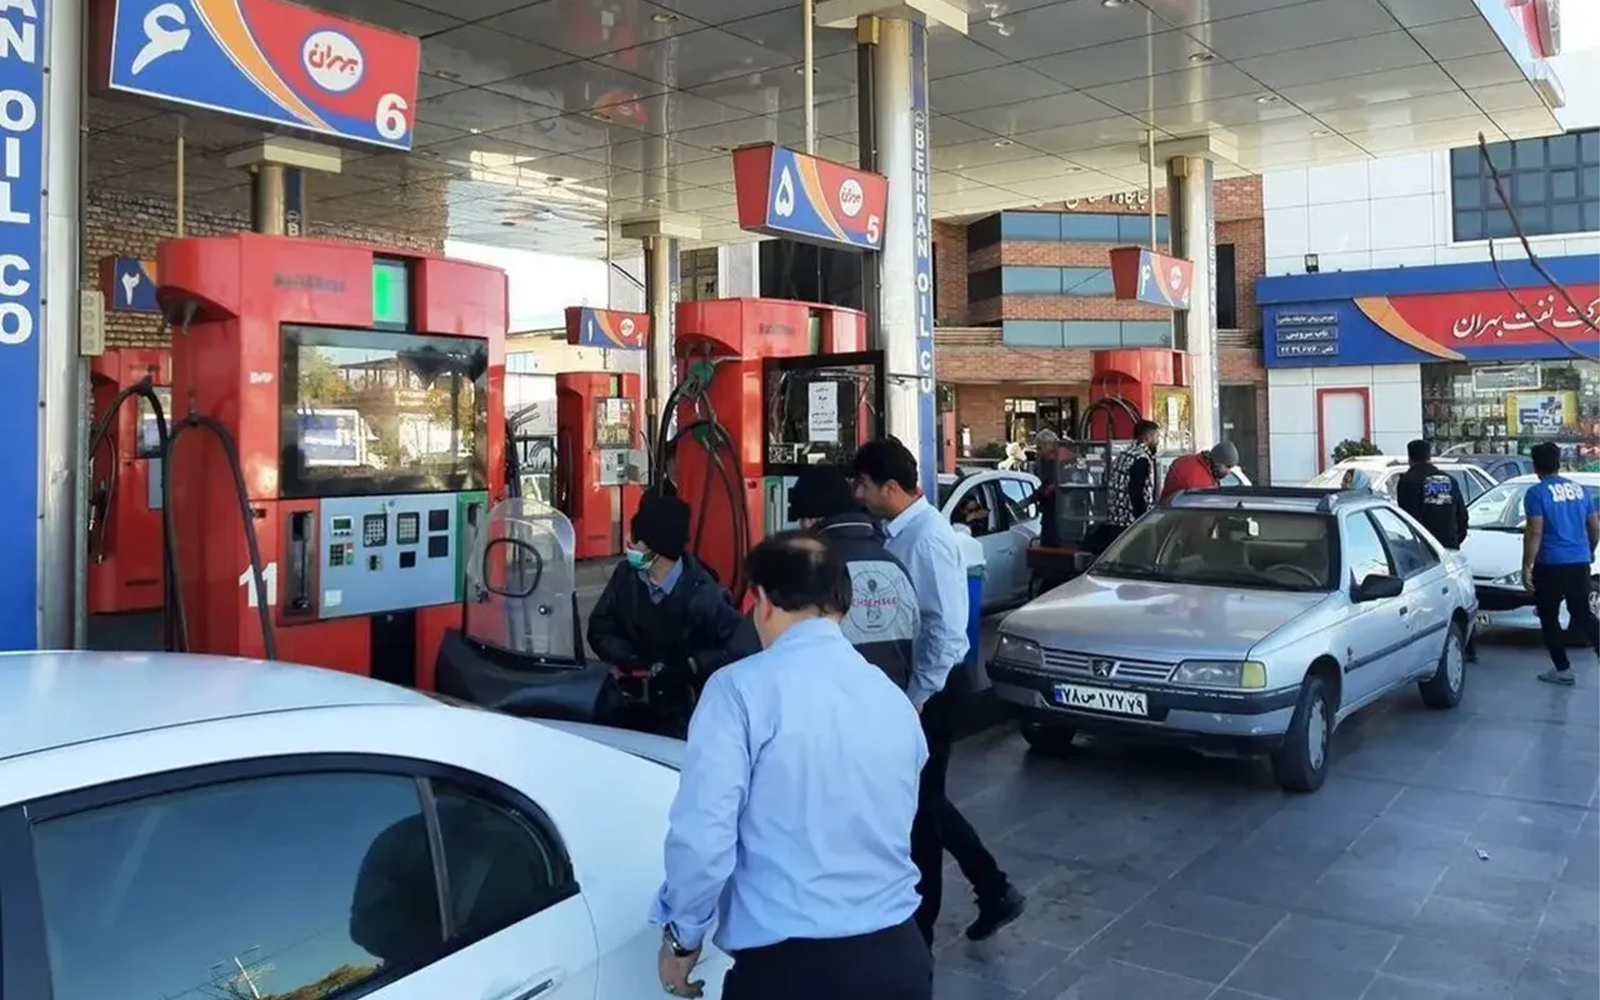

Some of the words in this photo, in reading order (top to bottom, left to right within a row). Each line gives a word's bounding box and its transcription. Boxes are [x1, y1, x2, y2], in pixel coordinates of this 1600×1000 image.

[131, 3, 191, 75] ۶
[375, 93, 408, 140] 6
[0, 89, 36, 224] OIL
[774, 165, 795, 217] ۵
[915, 129, 928, 258] BEHRAN
[866, 214, 880, 243] 5
[0, 254, 33, 344] CO
[917, 272, 930, 337] OIL
[1503, 295, 1554, 330] نفت
[636, 331, 644, 347] 1
[1453, 312, 1504, 338] بهران
[239, 562, 277, 607] 11
